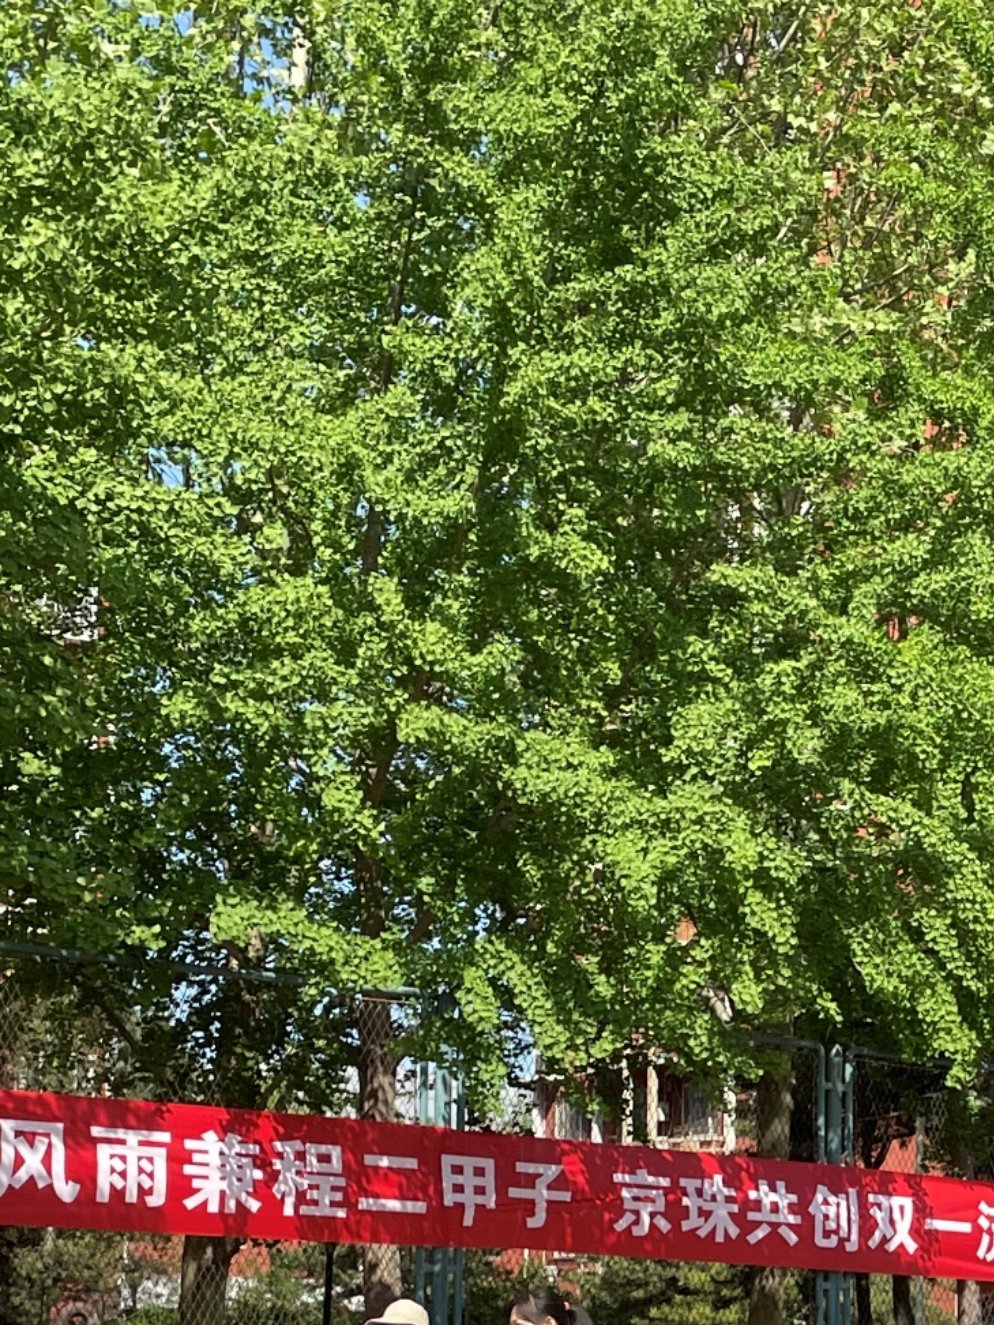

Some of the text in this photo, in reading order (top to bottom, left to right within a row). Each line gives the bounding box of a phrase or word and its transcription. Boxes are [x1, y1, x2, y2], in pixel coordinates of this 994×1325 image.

[0, 1118, 572, 1228] 风雨兼程二甲子
